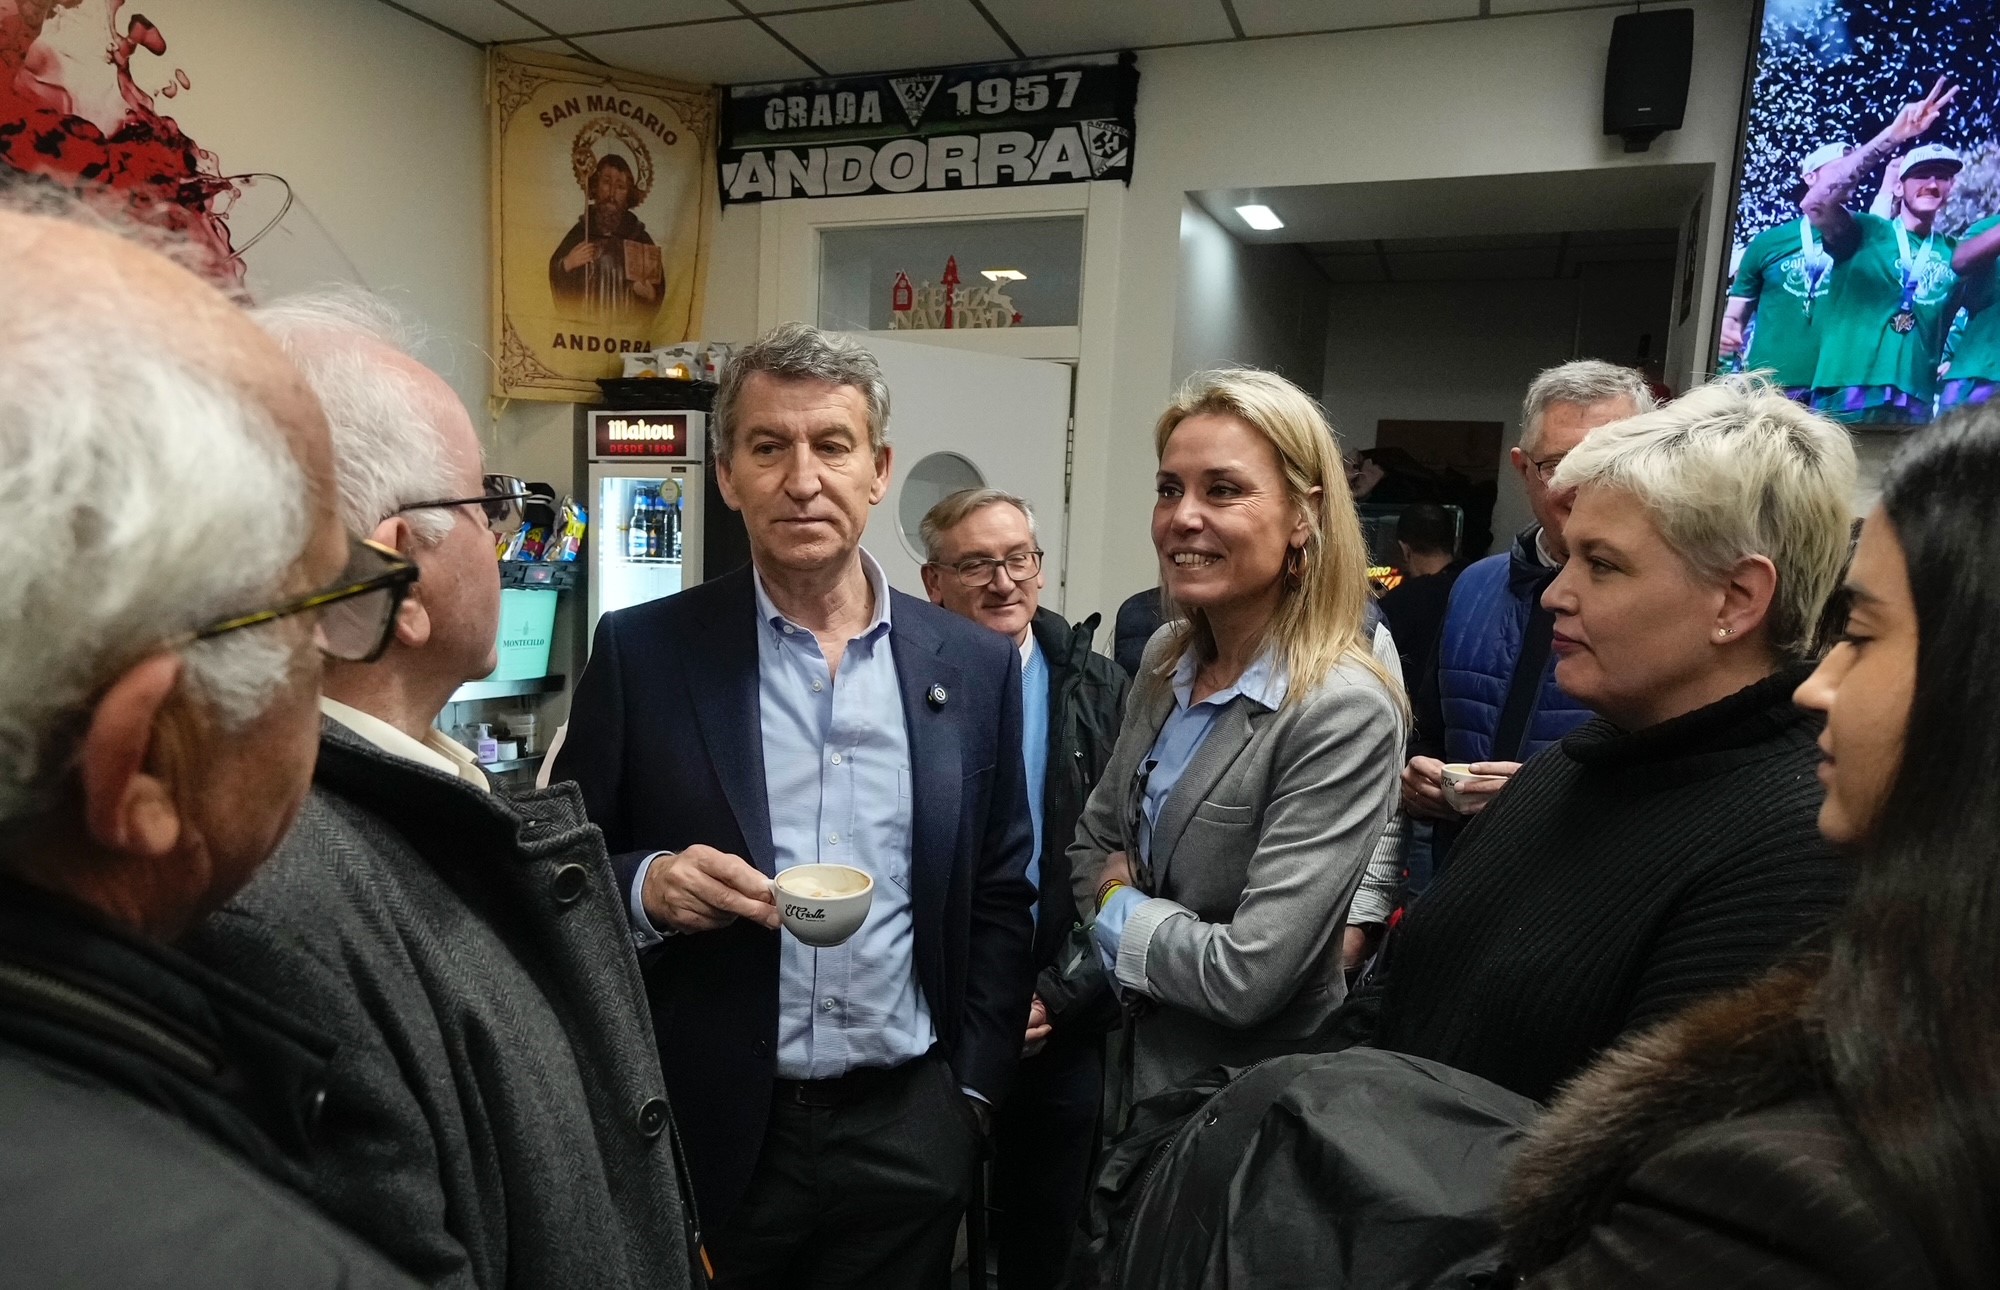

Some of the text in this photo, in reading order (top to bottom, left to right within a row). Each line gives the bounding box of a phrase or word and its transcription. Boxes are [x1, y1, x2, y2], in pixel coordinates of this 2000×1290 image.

[764, 71, 1083, 131] GRADA 1957
[540, 94, 678, 146] SAN MACARIO
[729, 126, 1092, 199] ANDORRA
[552, 332, 651, 353] ANDORRA
[607, 418, 675, 440] Mahou
[609, 443, 674, 454] DESDE 1890
[502, 638, 545, 648] MONTECILLO
[785, 904, 826, 920] El Criollo
